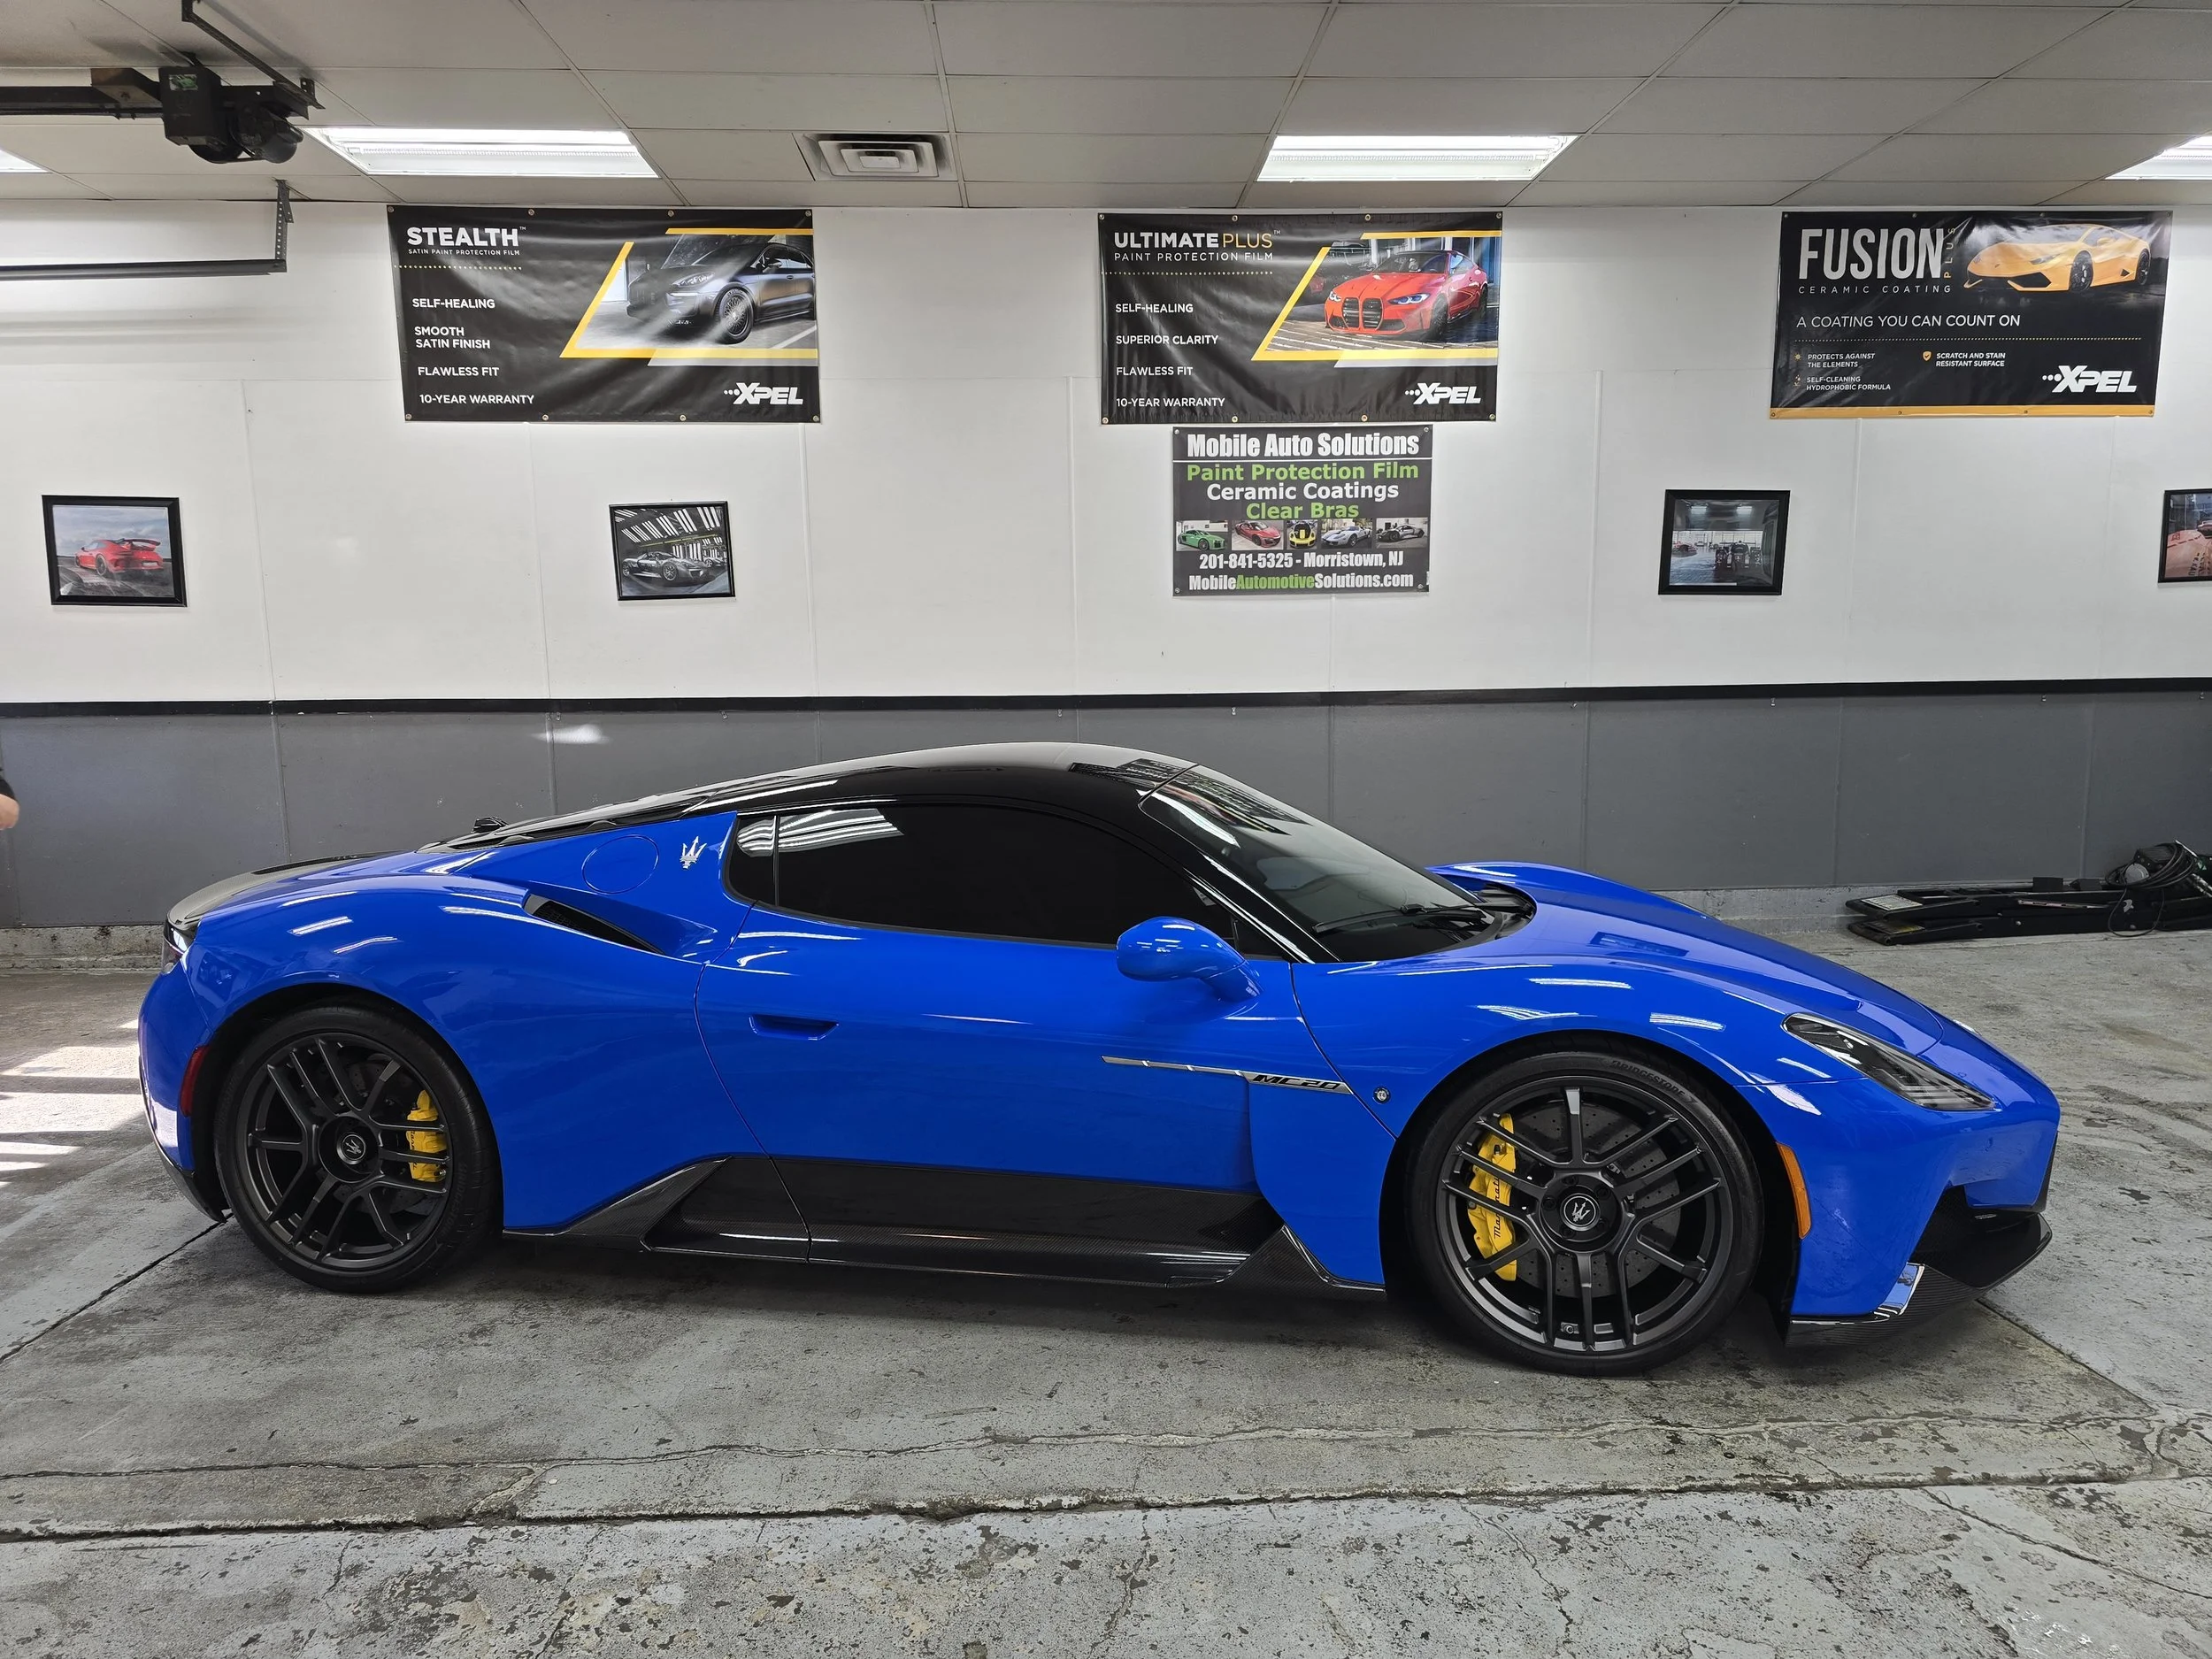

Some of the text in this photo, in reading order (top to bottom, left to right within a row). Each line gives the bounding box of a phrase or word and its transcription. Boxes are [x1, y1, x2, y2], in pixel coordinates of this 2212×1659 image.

[407, 227, 519, 247] STEALTH
[1114, 232, 1218, 249] ULTIMATE
[1223, 233, 1272, 248] PLUS
[1244, 252, 1272, 261] FILM
[1798, 227, 1944, 280] FUSION
[1944, 227, 1955, 279] PLUS
[1798, 285, 1951, 295] CERAMIC COATING
[412, 298, 495, 309] SELF-HEALING
[1115, 303, 1194, 313] SELF-HEALING
[1796, 314, 2020, 328] A COATING YOU CAN COUNT ON
[414, 326, 465, 336] SMOOTH
[416, 339, 490, 349] SATIN FINISH
[1116, 334, 1218, 345] SUPERIOR CLARITY
[418, 366, 499, 376] FLAWLESS FIT
[1116, 366, 1193, 376] FLAWLESS FIT
[2051, 365, 2138, 394] XPEL
[419, 395, 534, 404] 10-YEAR WARRANTY
[733, 382, 803, 405] XPEL
[1413, 381, 1481, 405] XPEL
[1116, 397, 1225, 407] 10-YEAR WARRANTY
[1187, 432, 1419, 457] Mobile Auto Solutions
[1187, 461, 1419, 481] Paint Protection Film
[1207, 481, 1399, 502] Ceramic Coatings
[1246, 502, 1359, 519] Clear Bras
[1199, 552, 1294, 570] 201-841-5325
[1304, 552, 1386, 568] Morristown,
[1388, 550, 1403, 566] NJ
[1188, 573, 1414, 591] MobileAutomotiveSolutions.com
[1252, 1074, 1340, 1090] MC20
